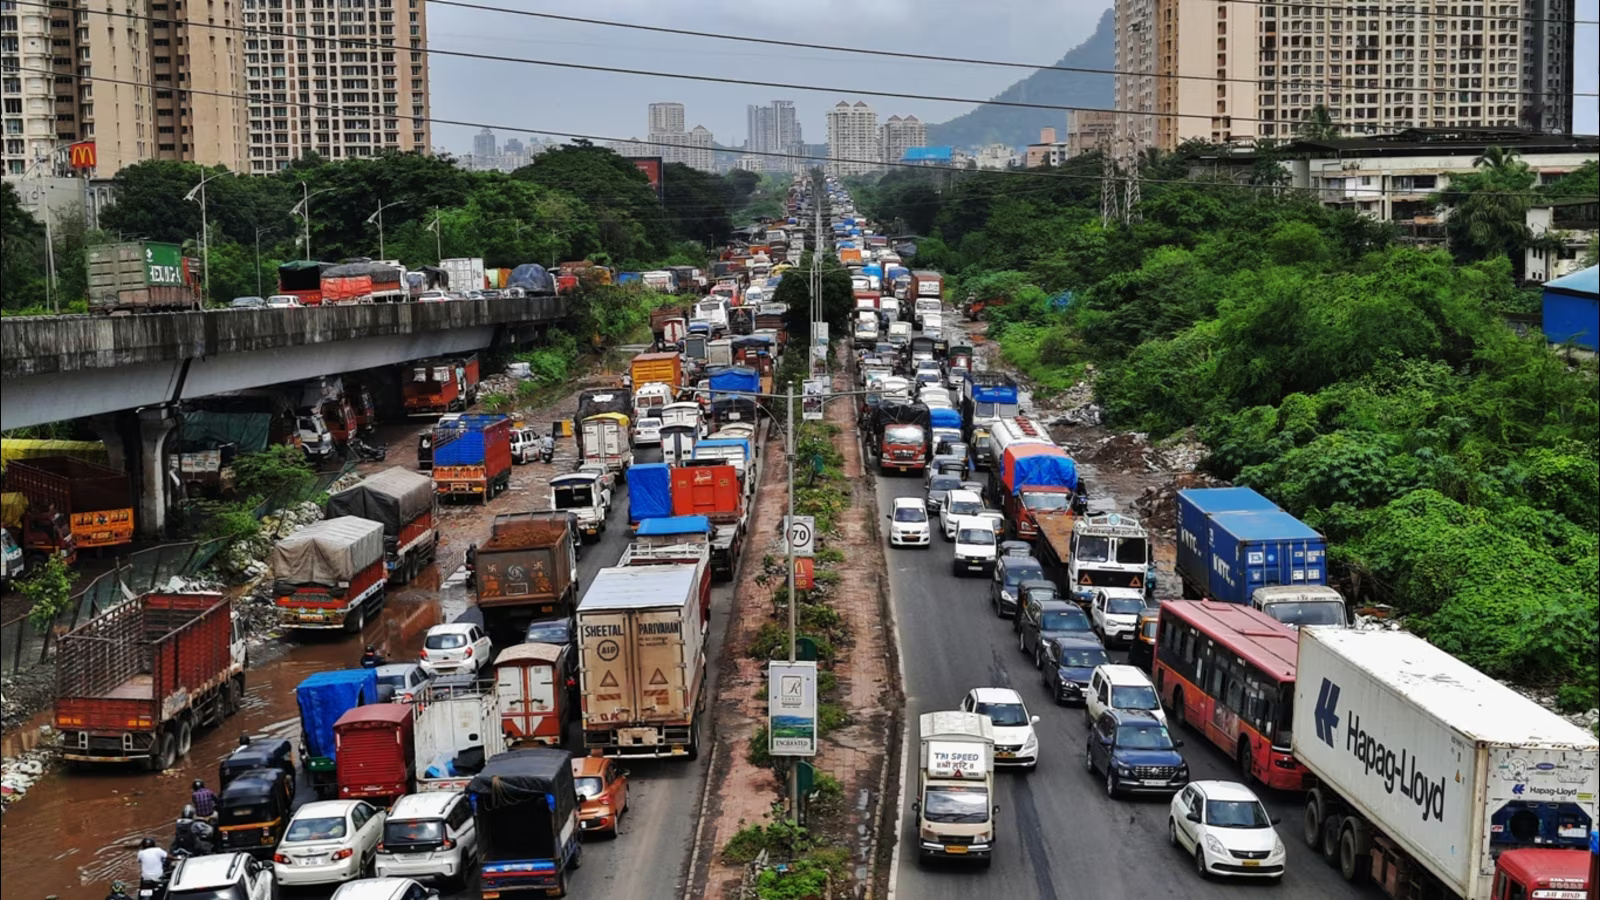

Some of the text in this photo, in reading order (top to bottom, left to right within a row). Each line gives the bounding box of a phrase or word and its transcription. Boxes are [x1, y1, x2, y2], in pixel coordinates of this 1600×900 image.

[793, 530, 806, 541] 70
[585, 622, 679, 637] SHEETAL PARIVAHAN
[934, 752, 979, 761] TRI SPEED
[1347, 710, 1446, 823] Hapag-Lloyd
[1529, 785, 1578, 796] Hapag-Lloyd
